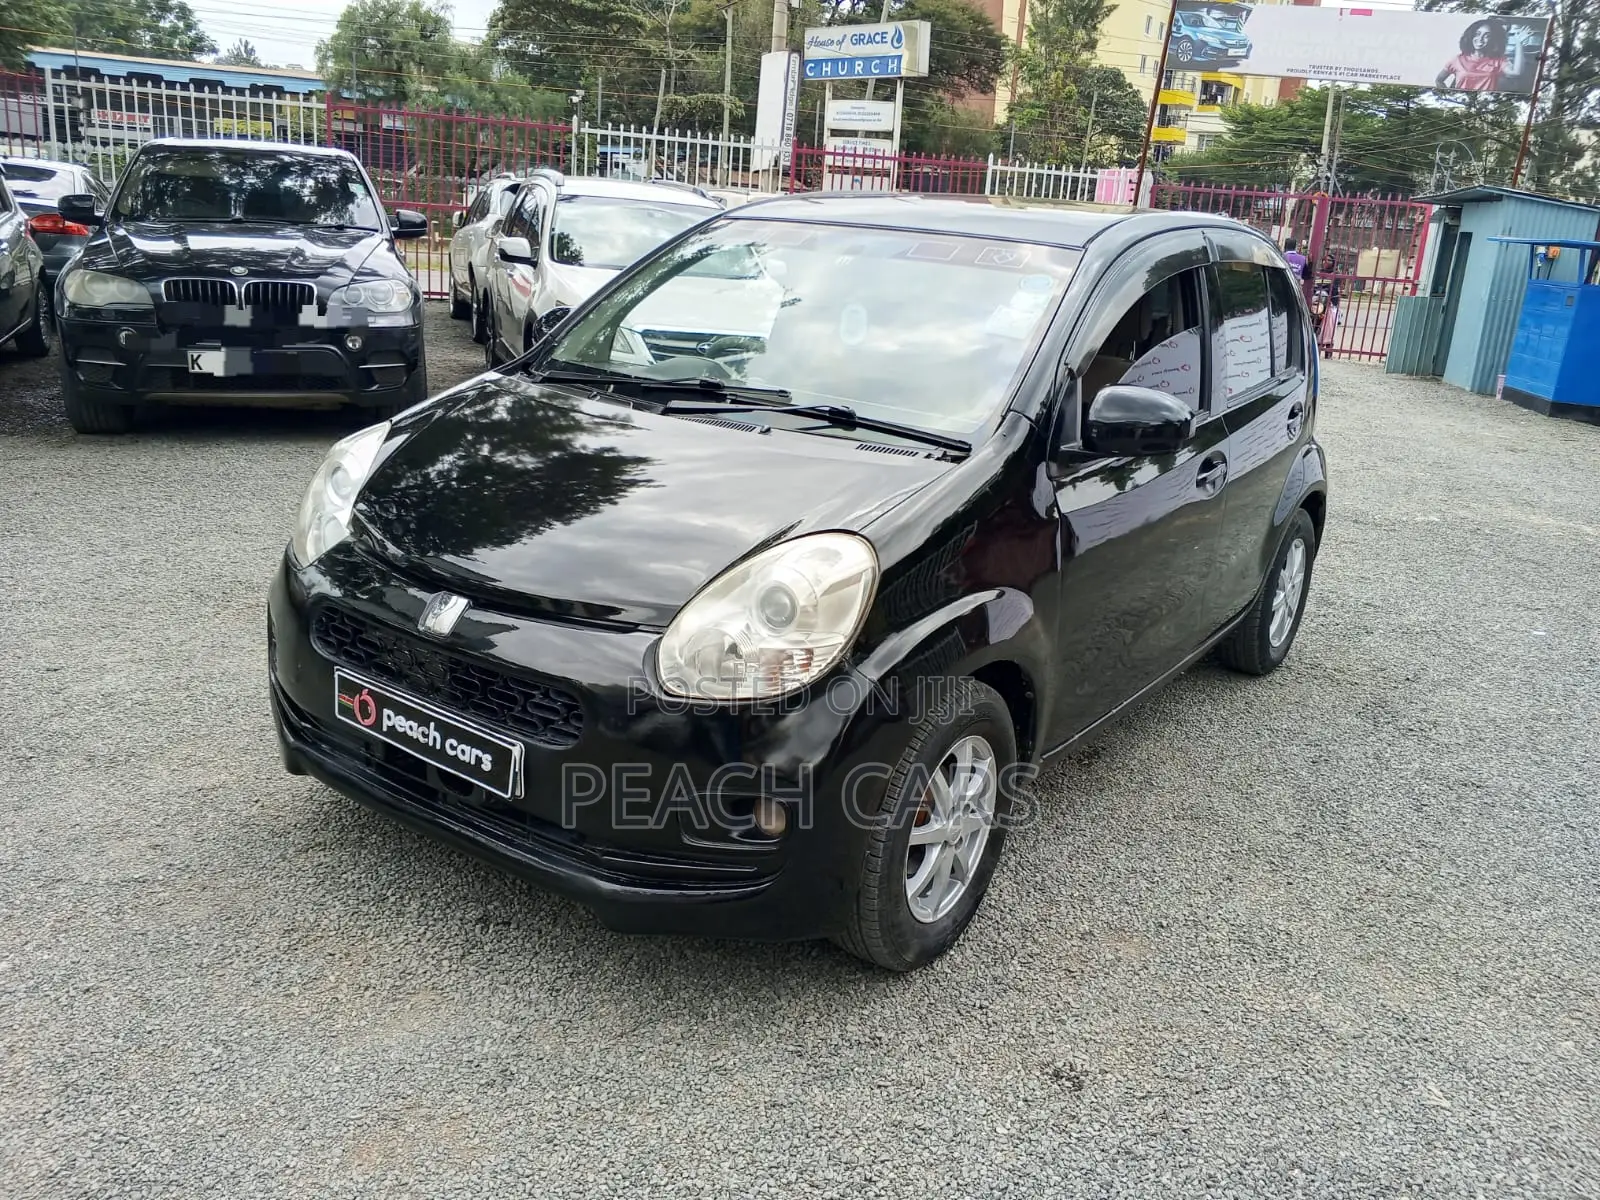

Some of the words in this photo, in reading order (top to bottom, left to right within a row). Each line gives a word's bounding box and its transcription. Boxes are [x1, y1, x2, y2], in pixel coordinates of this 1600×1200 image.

[807, 36, 834, 50] House
[836, 34, 847, 51] of
[850, 31, 889, 46] GRACE
[805, 58, 898, 76] CHURCH
[381, 708, 442, 750] peach
[444, 738, 493, 772] cars
